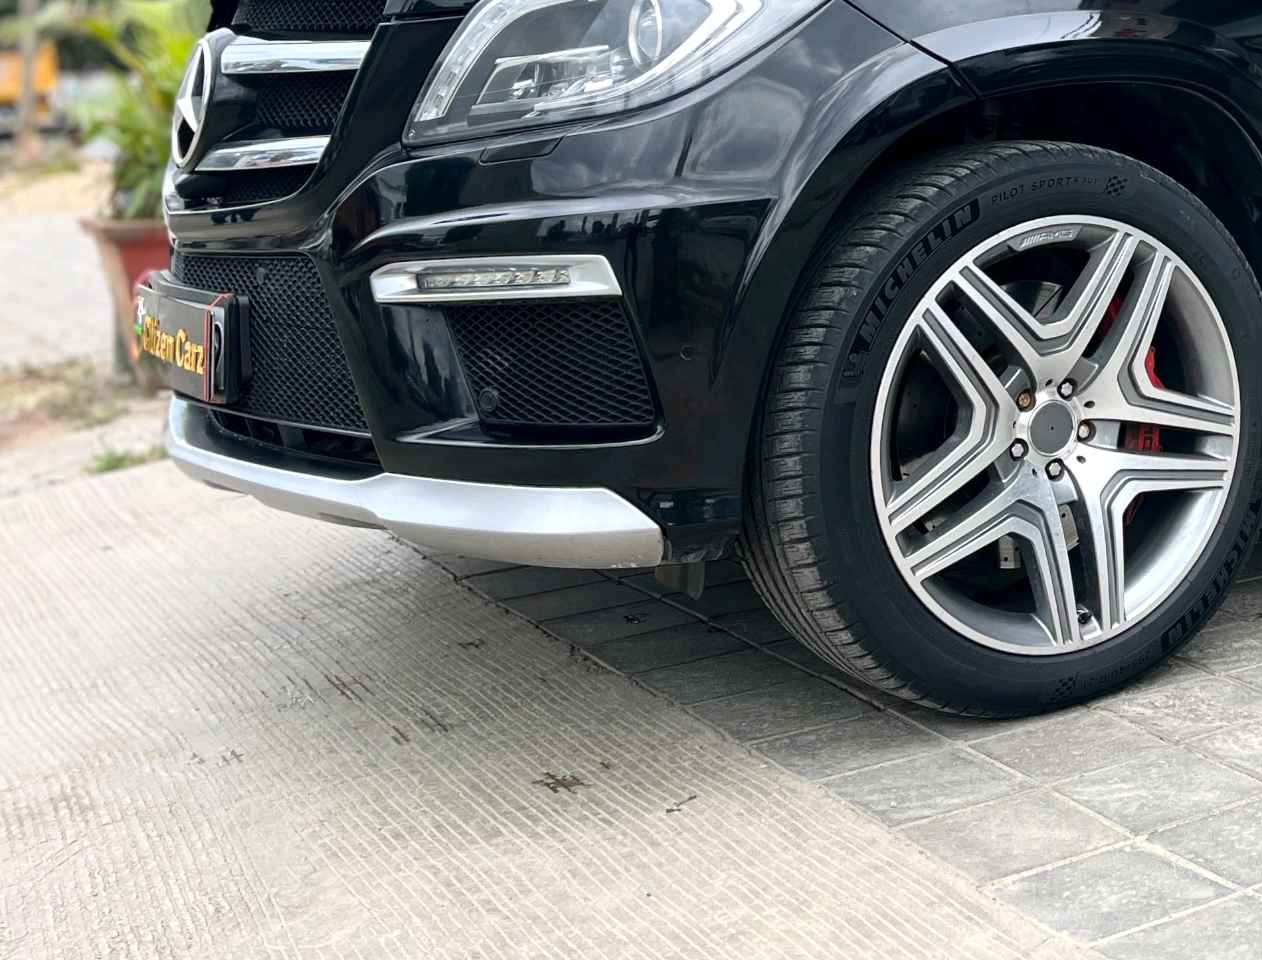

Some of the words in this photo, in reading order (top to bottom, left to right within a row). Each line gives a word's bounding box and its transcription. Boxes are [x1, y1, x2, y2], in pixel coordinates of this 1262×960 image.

[991, 184, 1025, 204] PILOT
[1031, 176, 1072, 192] SPORT
[857, 203, 974, 342] MICHELIN
[176, 328, 204, 375] Carz
